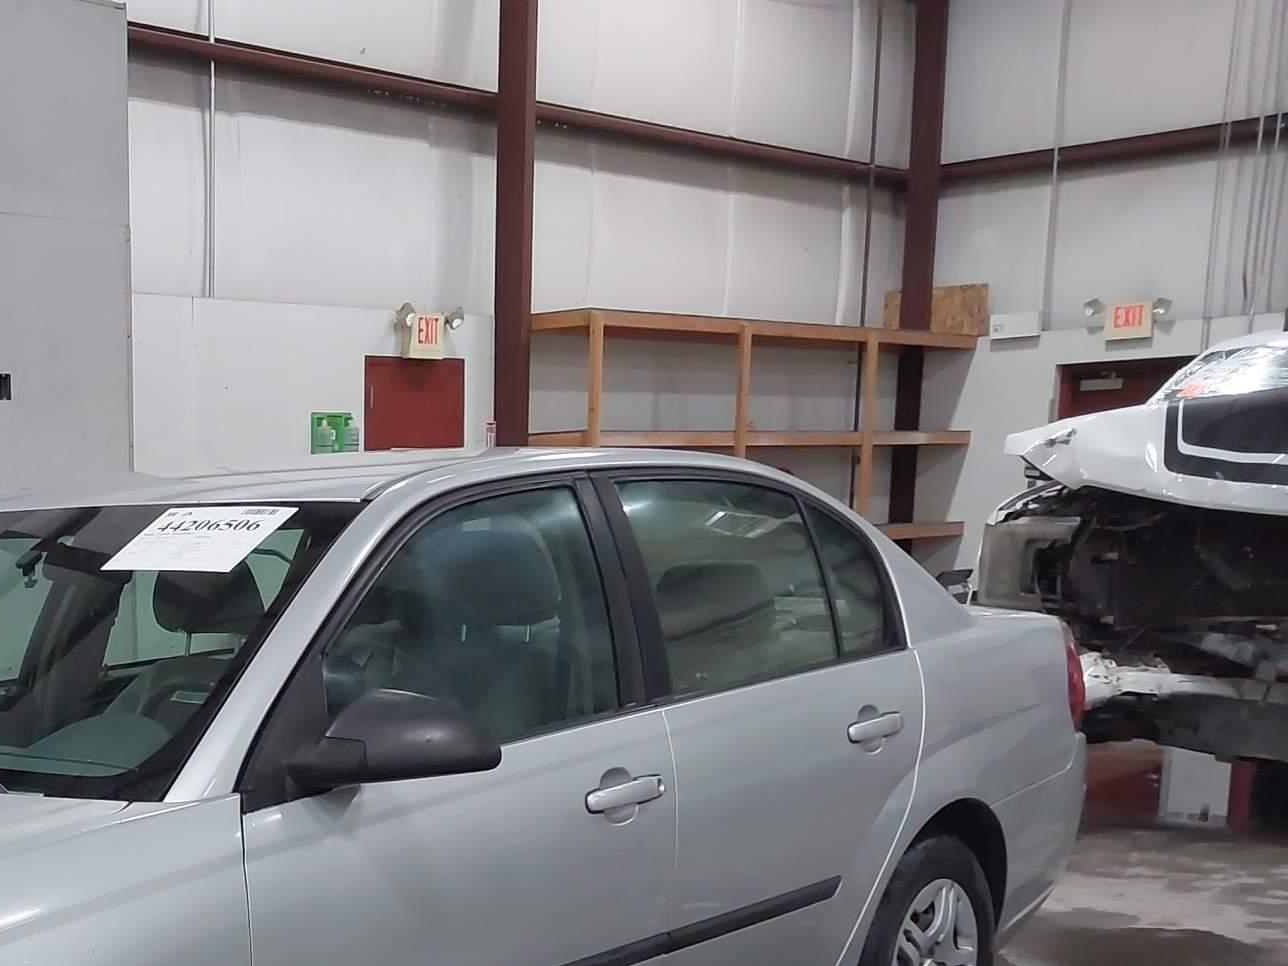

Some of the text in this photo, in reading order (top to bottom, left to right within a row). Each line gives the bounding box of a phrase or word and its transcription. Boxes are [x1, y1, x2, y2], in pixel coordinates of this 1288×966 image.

[1114, 305, 1145, 328] EXIT
[417, 317, 440, 345] EXIT
[157, 519, 263, 532] 44206506
